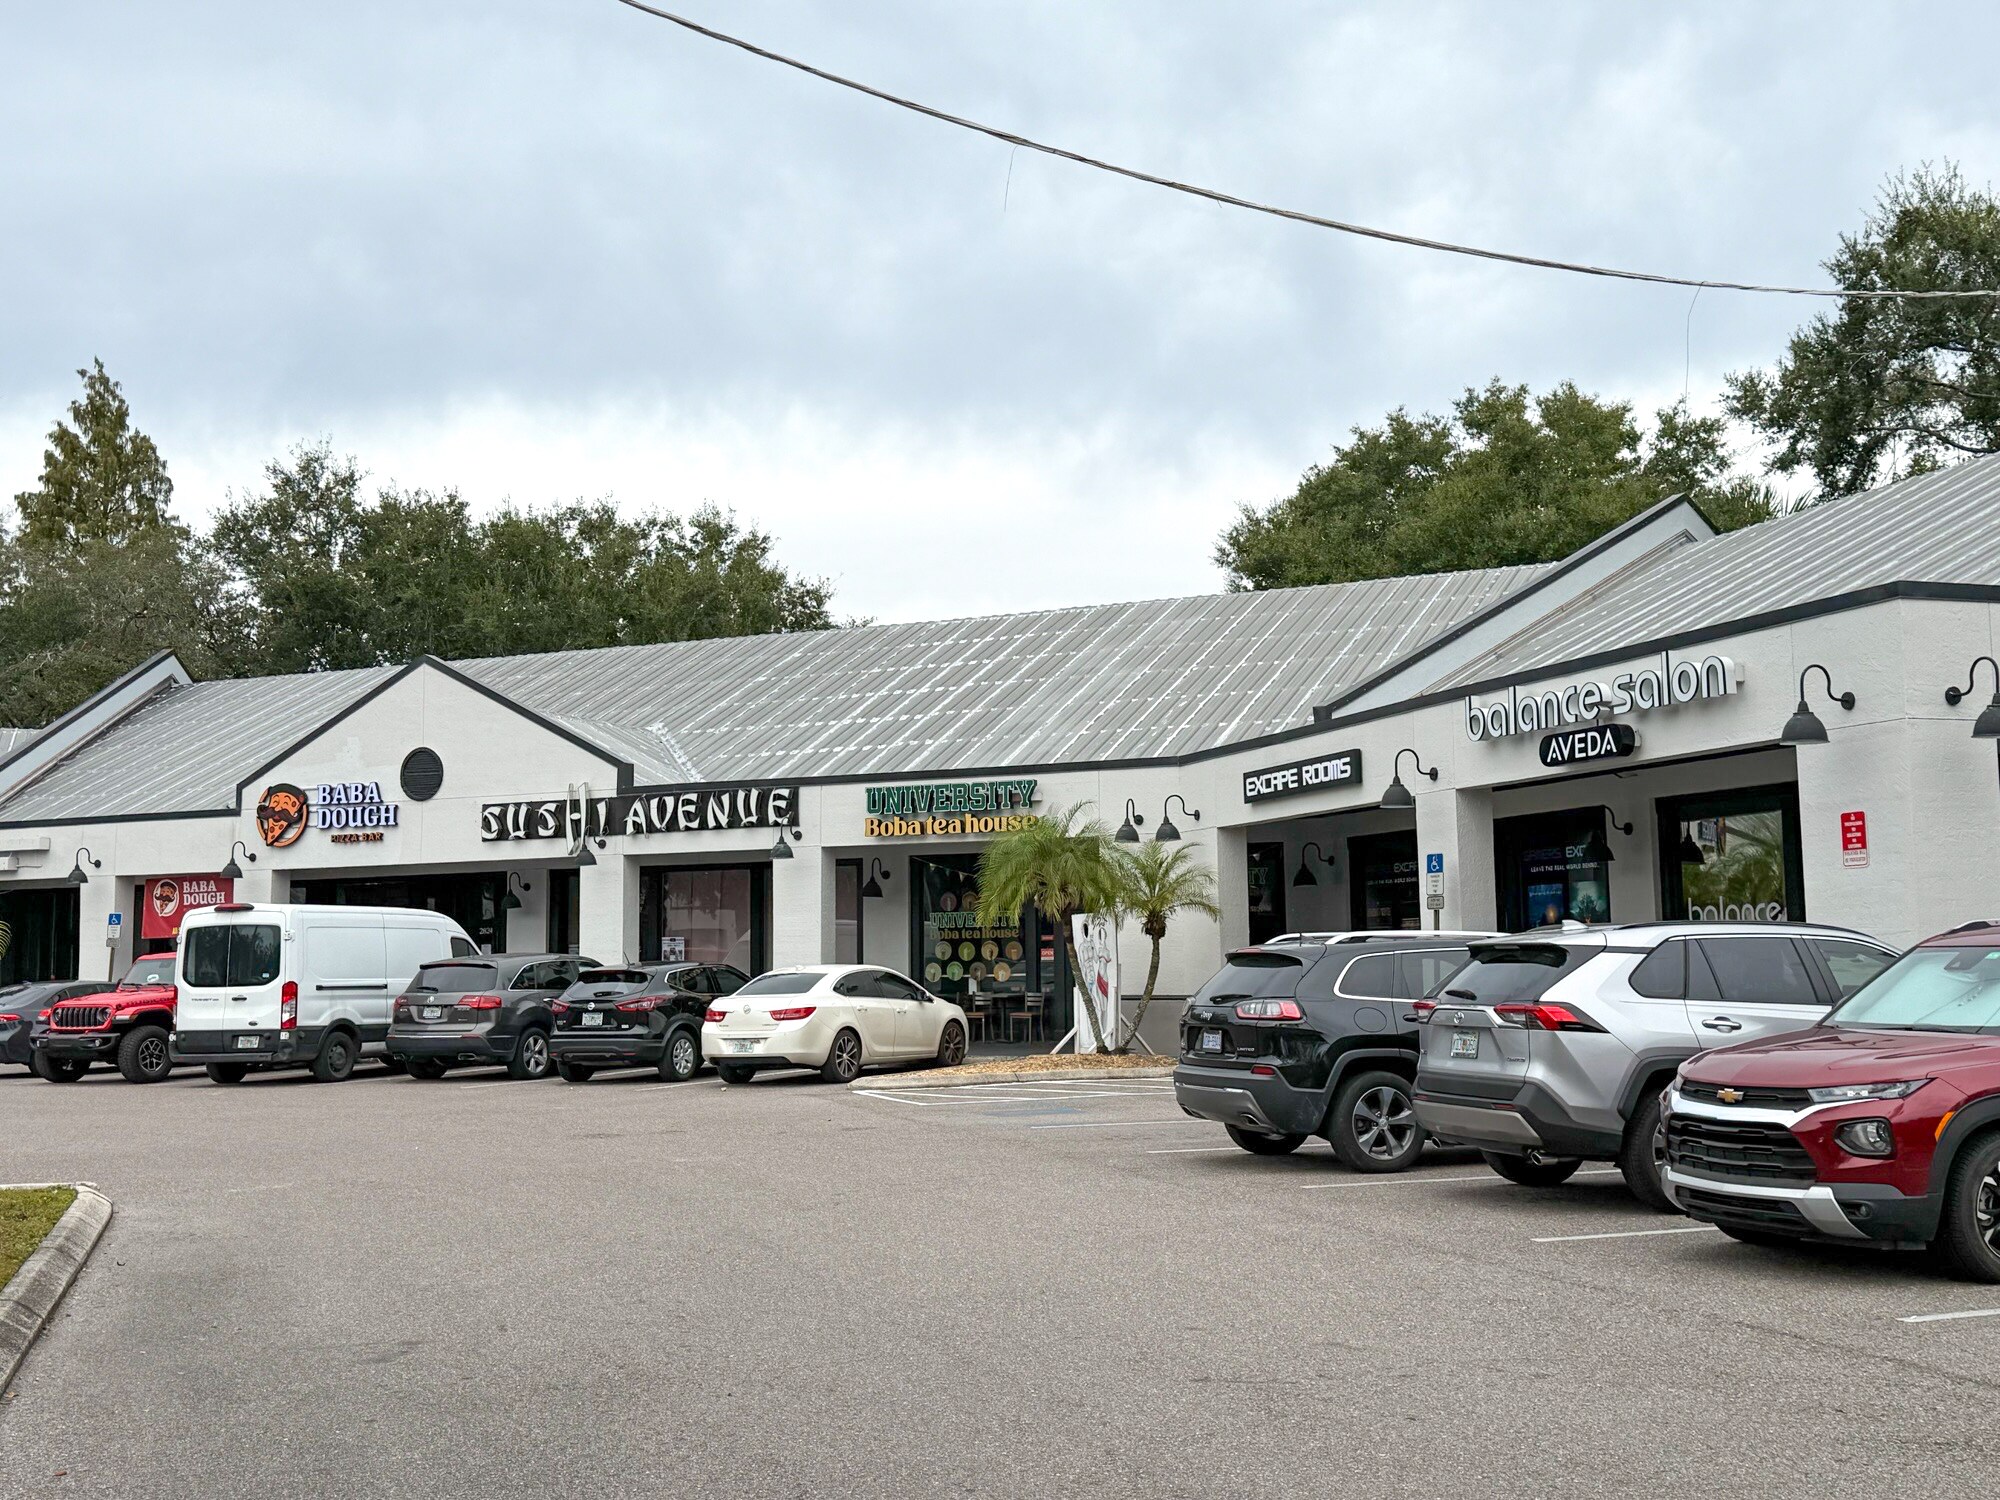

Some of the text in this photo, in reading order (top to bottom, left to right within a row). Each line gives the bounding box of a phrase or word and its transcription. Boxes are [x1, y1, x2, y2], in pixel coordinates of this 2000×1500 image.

[1464, 650, 1735, 742] balance salon
[1546, 727, 1618, 763] AVEDA
[1245, 756, 1352, 797] EXCAPE ROOMS
[317, 781, 383, 805] BABA
[865, 779, 1038, 815] UNIVERSITY
[317, 804, 398, 830] DOUGH
[481, 782, 794, 856] SUSHI AVENUE
[865, 813, 1039, 838] Boba tea house
[330, 831, 385, 844] PIZZA BAR
[182, 879, 217, 893] BABA
[183, 891, 226, 906] DOUGH
[1687, 895, 1782, 921] balance
